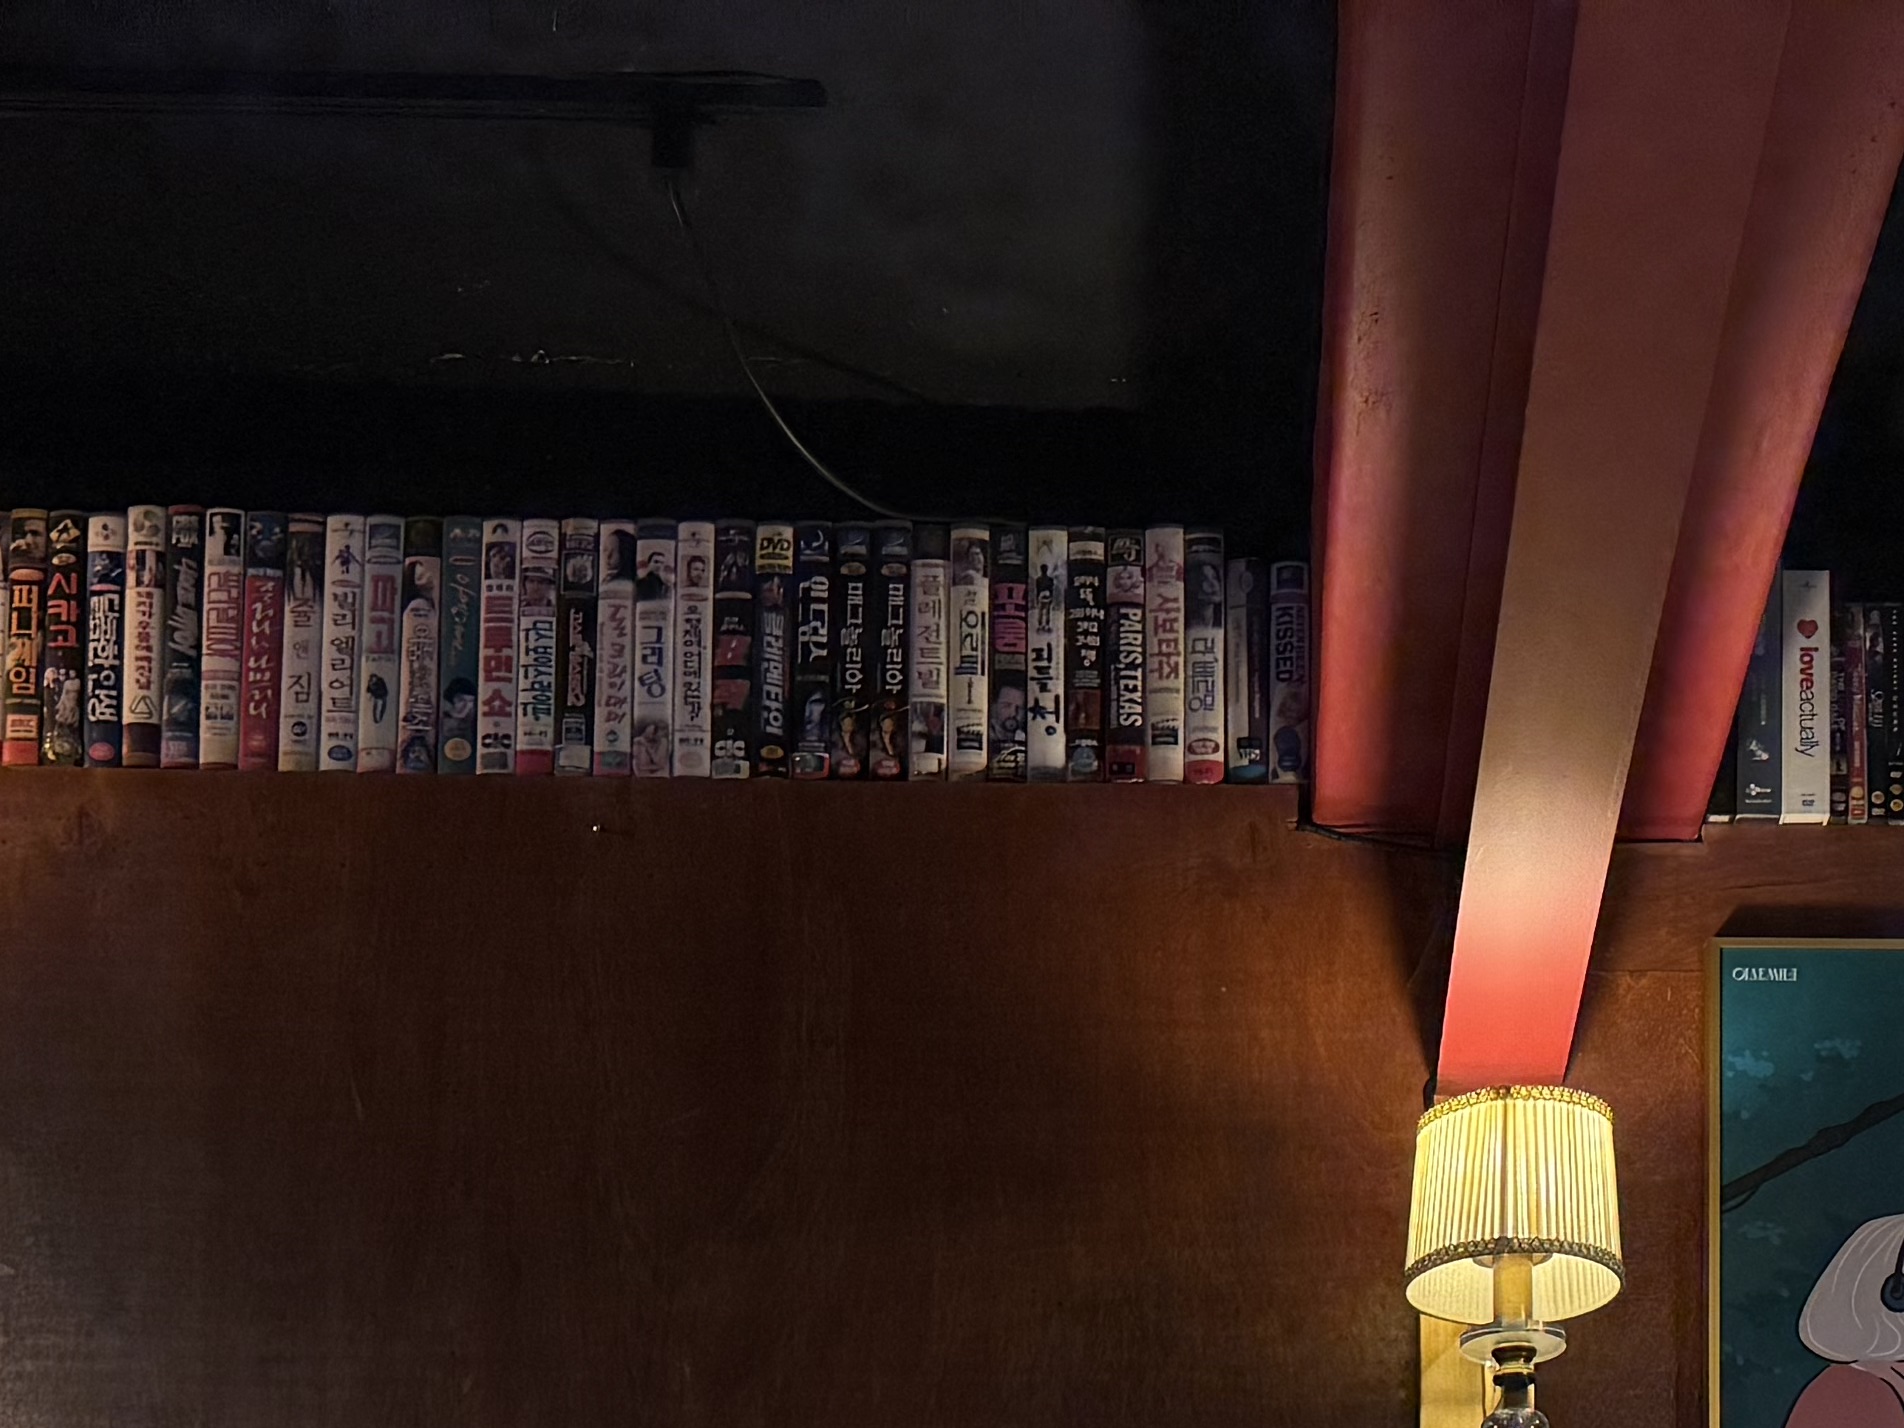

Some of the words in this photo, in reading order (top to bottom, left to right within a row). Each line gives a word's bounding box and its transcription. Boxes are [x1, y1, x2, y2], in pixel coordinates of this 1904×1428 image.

[759, 535, 792, 551] DVD
[46, 572, 80, 649] 시카고
[331, 590, 357, 630] 빌리
[483, 595, 514, 684] 트루먼
[840, 581, 863, 693] 매그놀리아
[880, 582, 905, 694] 매그놀리아
[1274, 605, 1293, 683] KISSED
[327, 636, 357, 714] 엘리어트
[481, 687, 513, 718] 쇼
